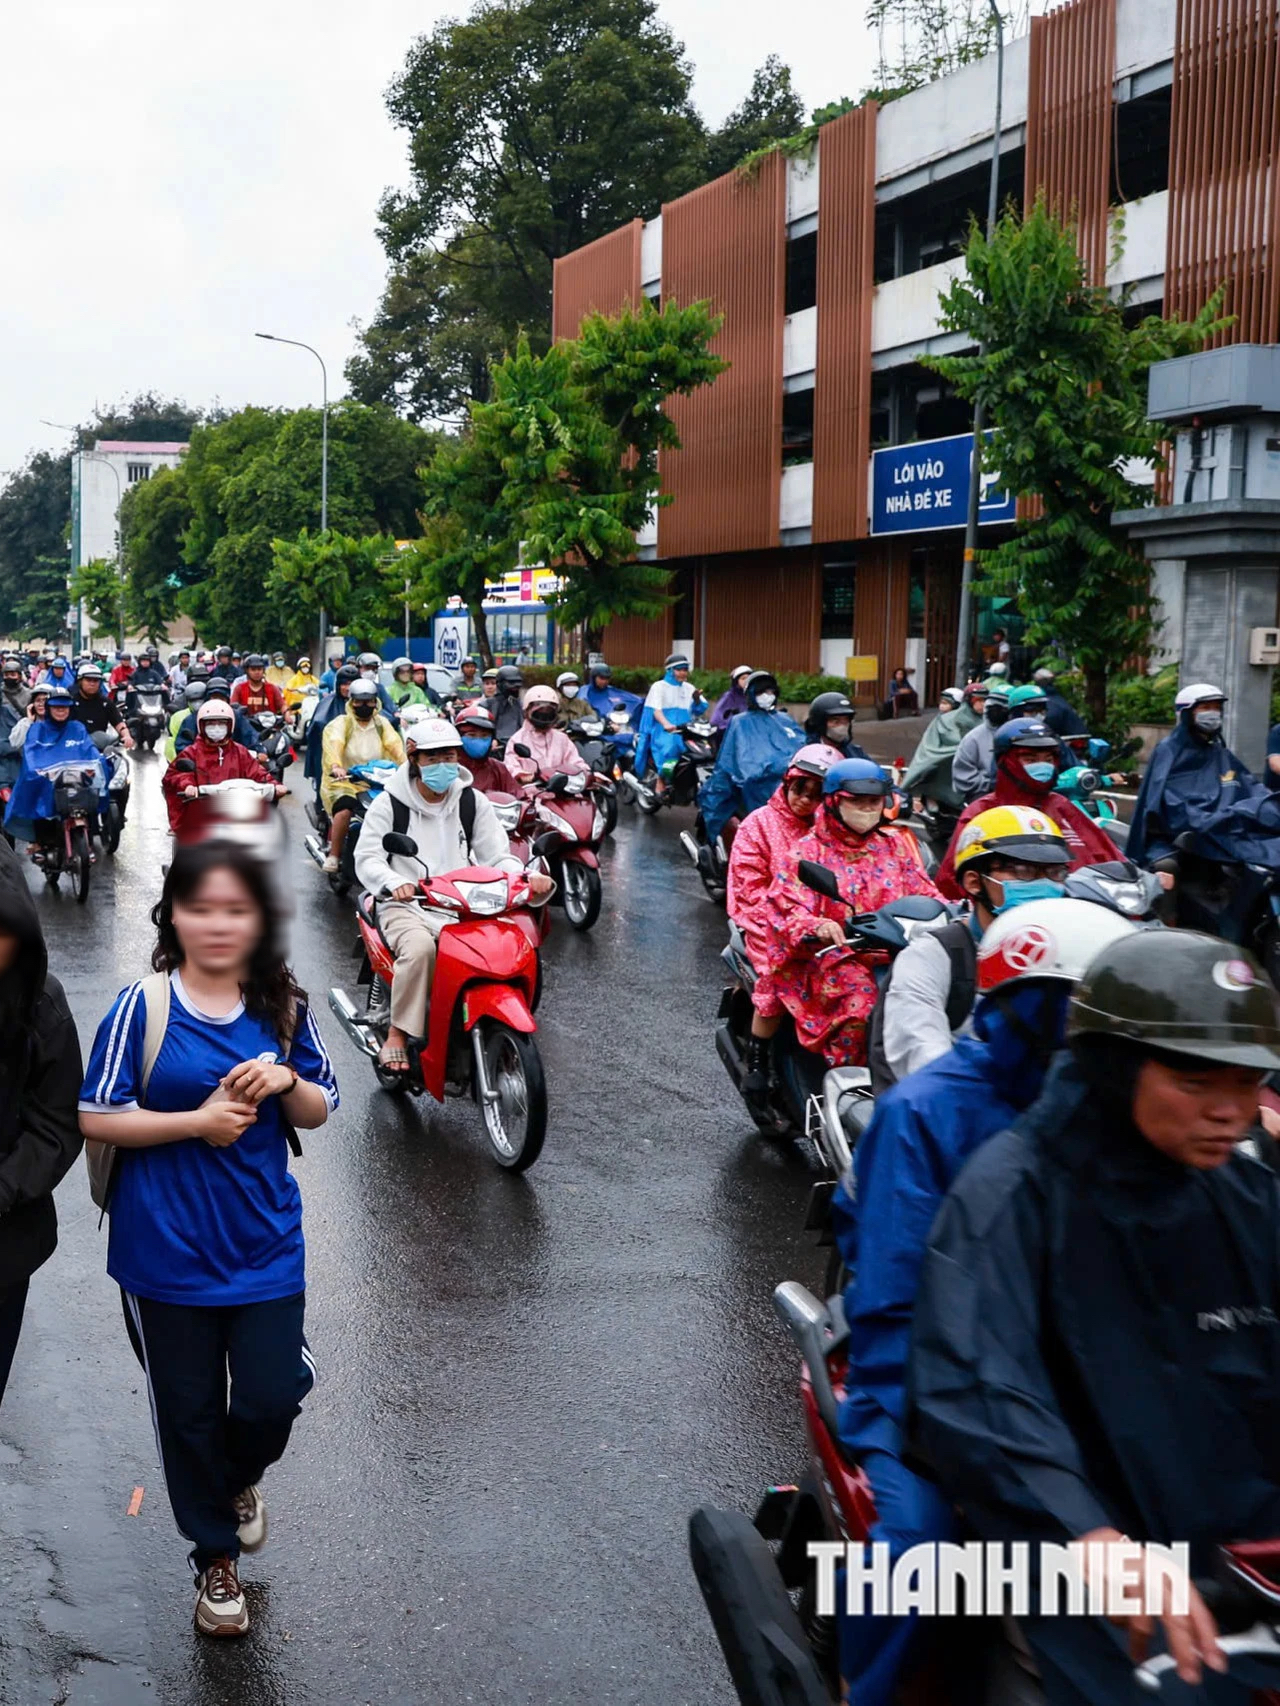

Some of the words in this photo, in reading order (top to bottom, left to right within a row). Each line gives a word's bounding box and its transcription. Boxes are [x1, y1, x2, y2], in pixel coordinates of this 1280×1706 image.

[894, 461, 915, 484] LỐI
[916, 458, 944, 480] VÀO
[886, 491, 912, 513] NHÀ
[934, 489, 952, 508] XE
